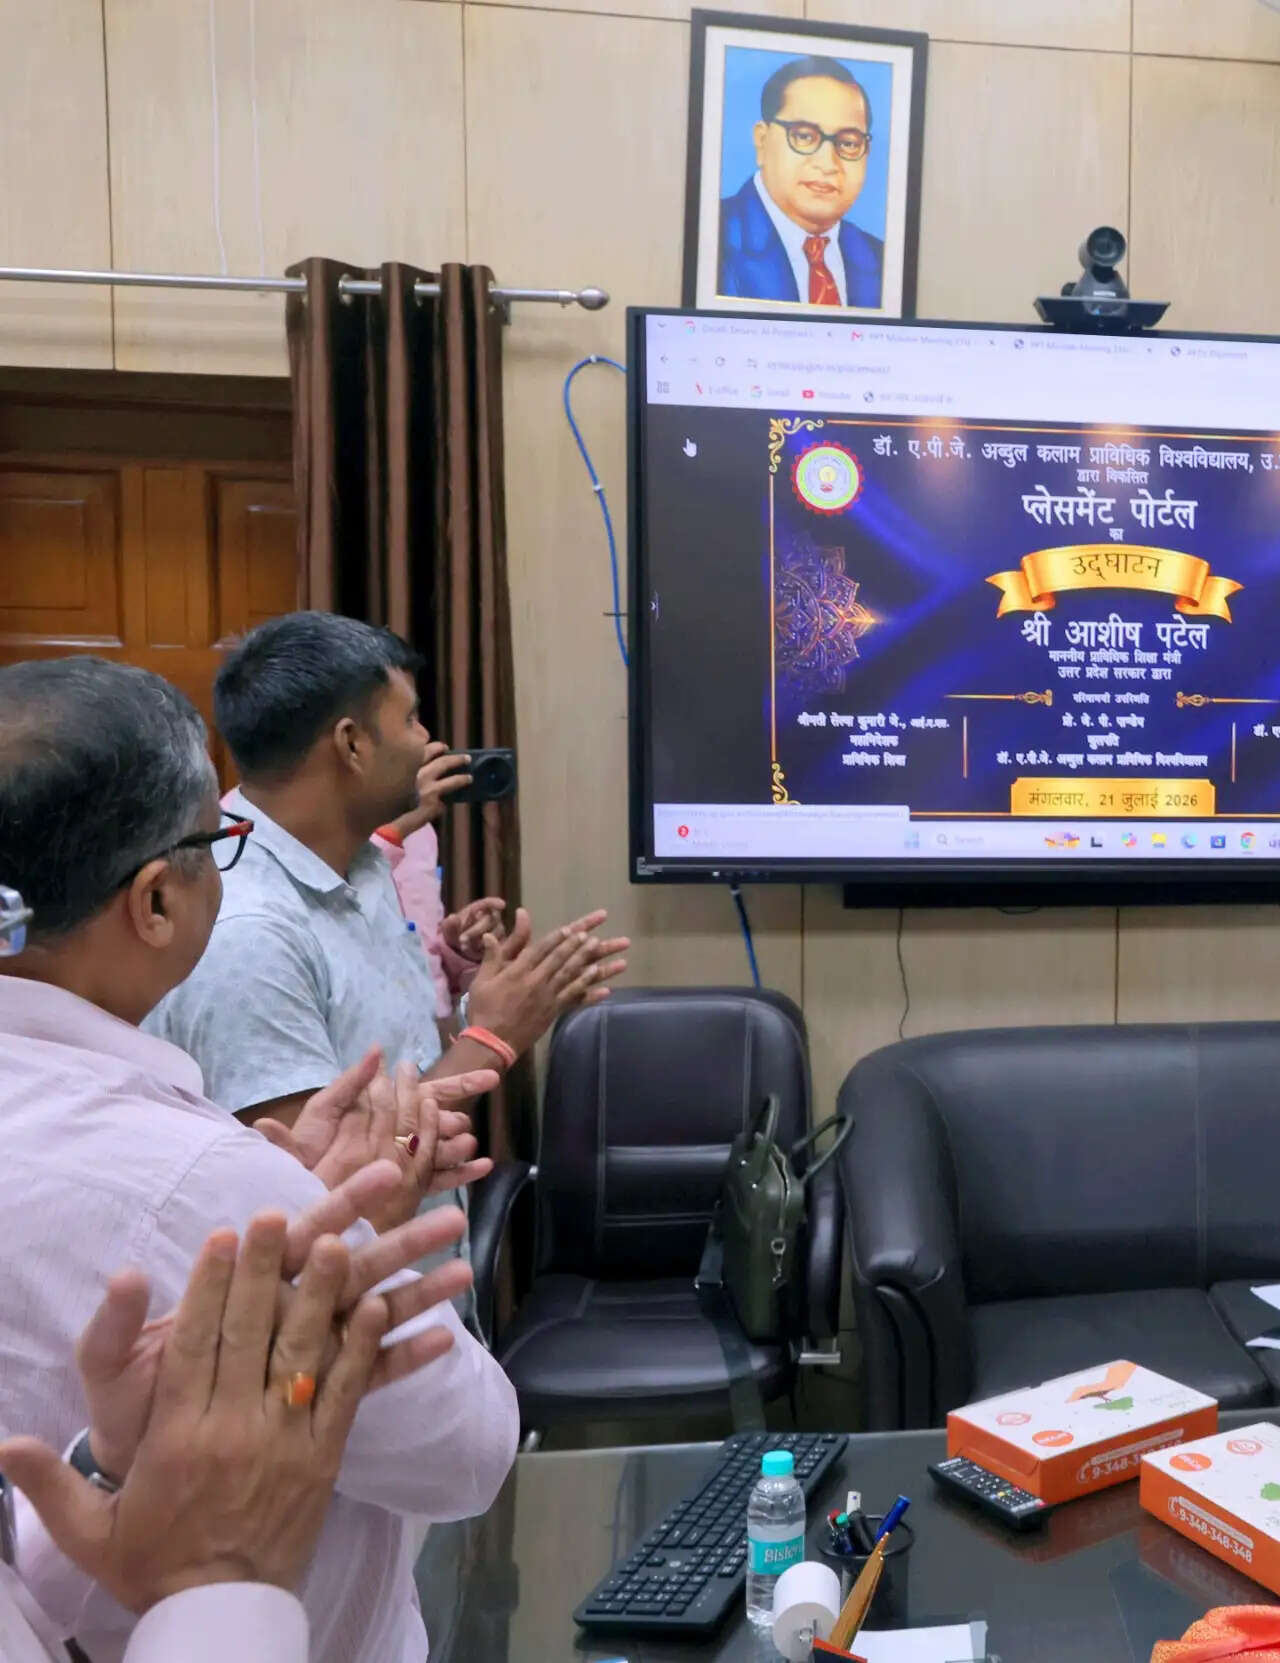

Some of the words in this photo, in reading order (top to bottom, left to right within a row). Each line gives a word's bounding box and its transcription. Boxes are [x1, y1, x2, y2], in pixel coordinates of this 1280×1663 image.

[873, 433, 898, 456] डॉ.
[908, 436, 971, 460] ए.पी.जे.
[982, 442, 1028, 468] अब्दुल
[1036, 443, 1081, 464] कलाम
[1089, 443, 1150, 468] प्राविधिक
[1159, 445, 1253, 473] विश्वविद्यालय,
[1106, 467, 1149, 485] विकसित
[1021, 485, 1117, 527] प्लेसमेंट
[1129, 488, 1199, 529] पोर्टल
[1109, 528, 1124, 541] का
[1021, 611, 1051, 647] श्री
[1065, 612, 1143, 648] आशीष
[1156, 613, 1210, 649] पटेल
[1048, 648, 1085, 663] माननीय
[1058, 666, 1081, 680] उत्तर
[1086, 664, 1108, 680] प्रदेश
[1113, 667, 1146, 681] सरकार
[1099, 794, 1114, 806] 21
[1121, 787, 1159, 811] जुलाई
[1165, 794, 1198, 806] 2026
